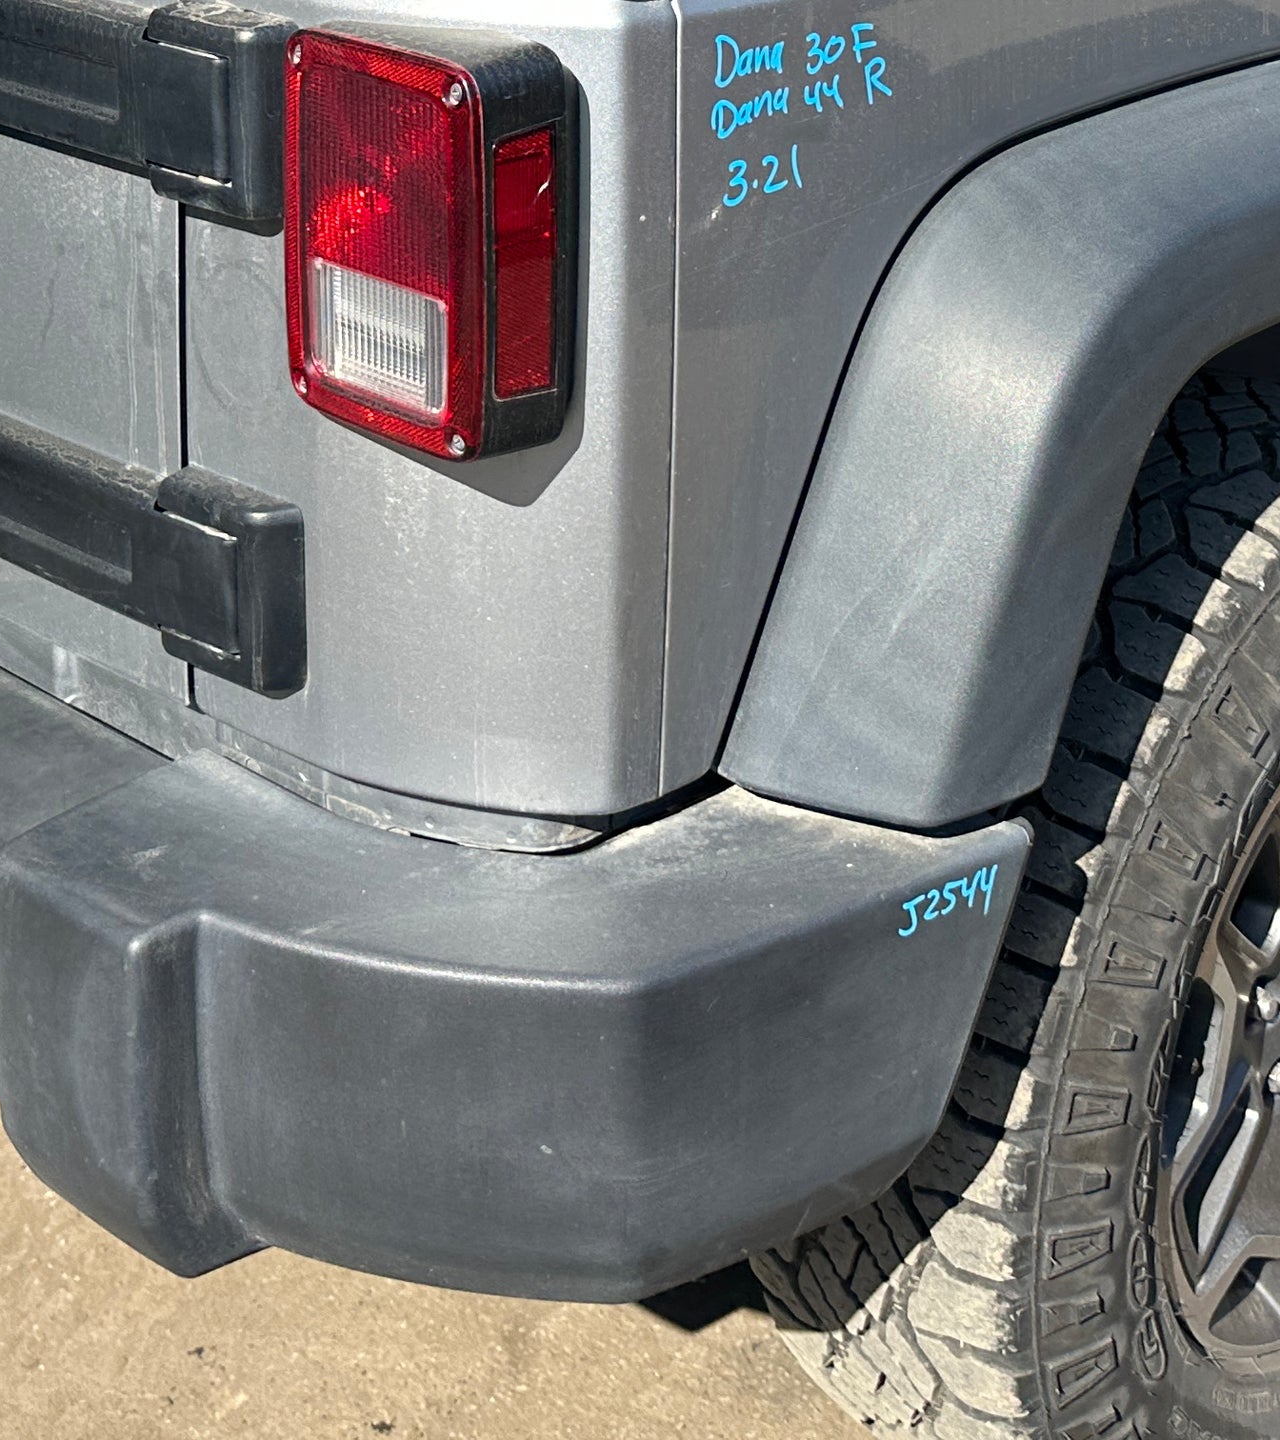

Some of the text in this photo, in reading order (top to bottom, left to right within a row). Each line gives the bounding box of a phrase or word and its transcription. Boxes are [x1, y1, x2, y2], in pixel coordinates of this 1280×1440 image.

[713, 33, 785, 89] Dana
[710, 56, 894, 140] Dana 44 R
[722, 143, 804, 208] 3.21
[897, 863, 1000, 937] J2544
